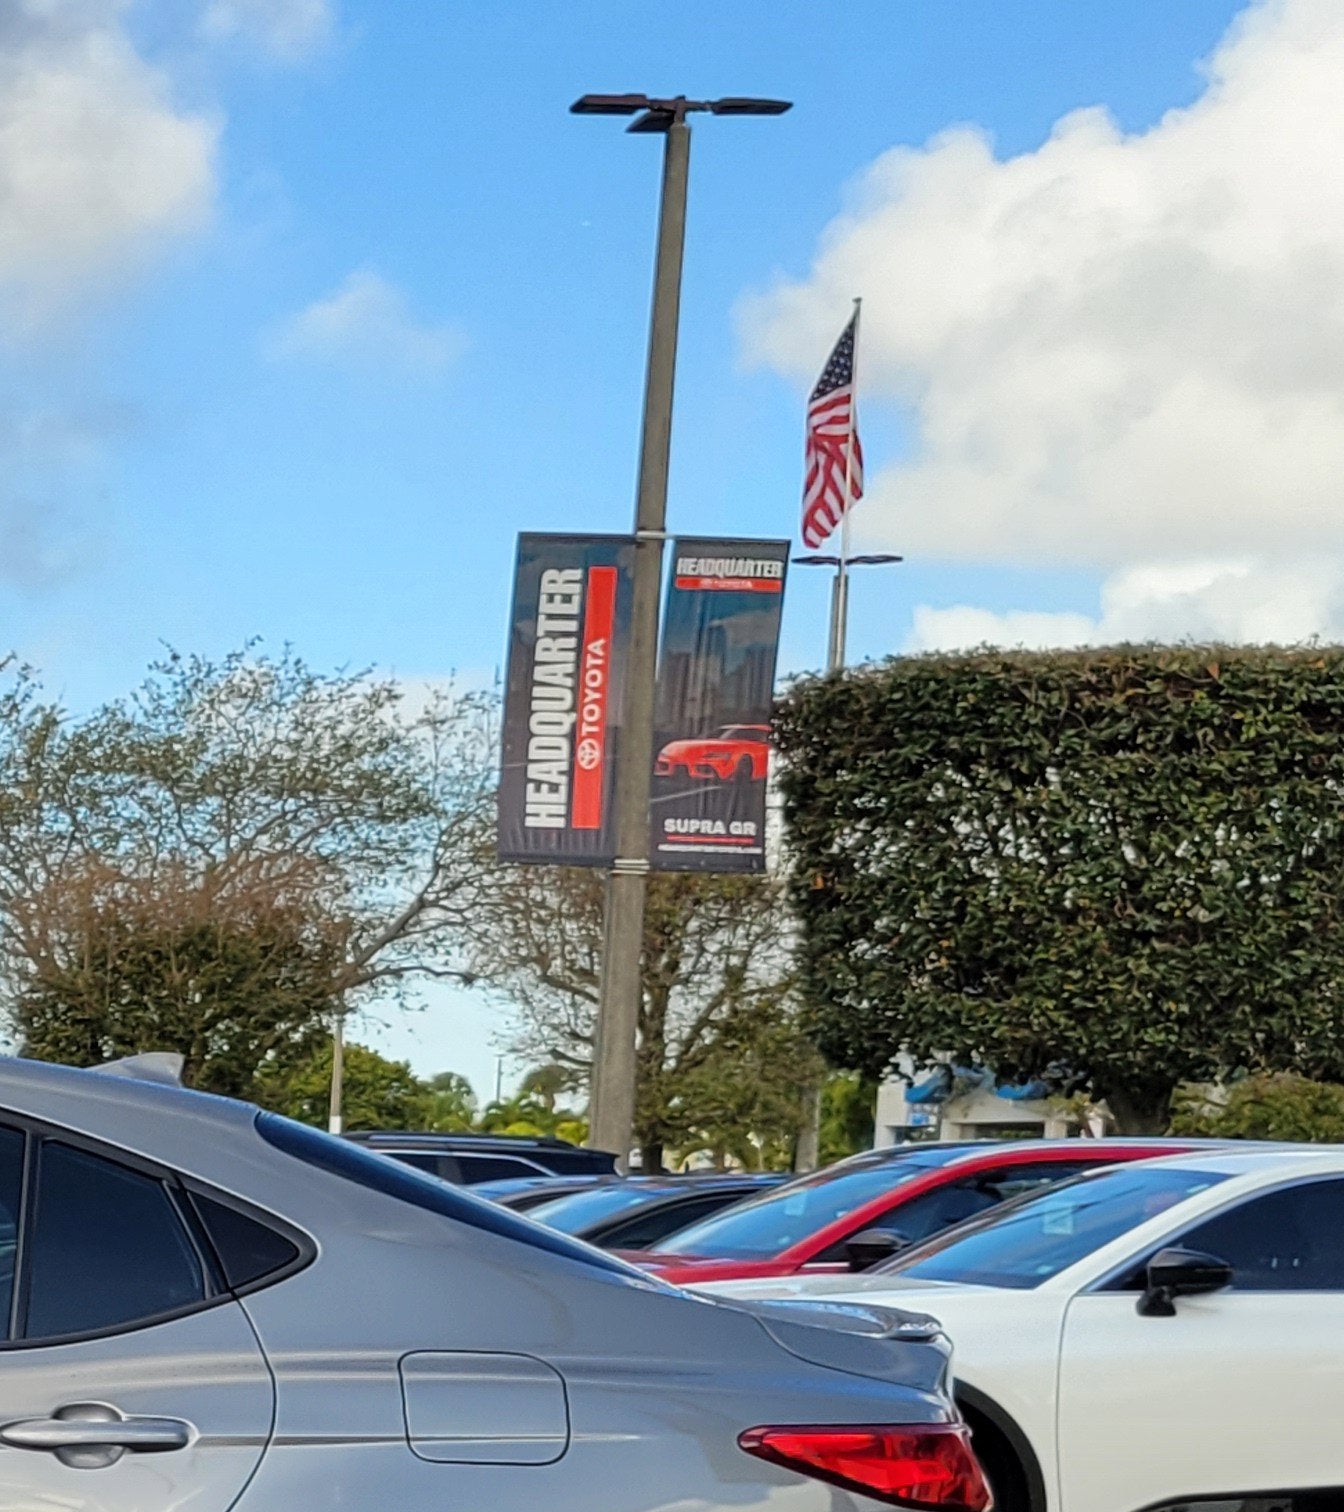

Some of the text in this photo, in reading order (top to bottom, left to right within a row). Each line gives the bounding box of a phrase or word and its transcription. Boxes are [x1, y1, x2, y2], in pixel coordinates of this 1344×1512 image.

[677, 557, 784, 578] HEADQUARTER
[524, 568, 584, 829] HEADQUARTER
[581, 638, 607, 736] TOYOTA
[664, 818, 757, 836] SUPRA GR
